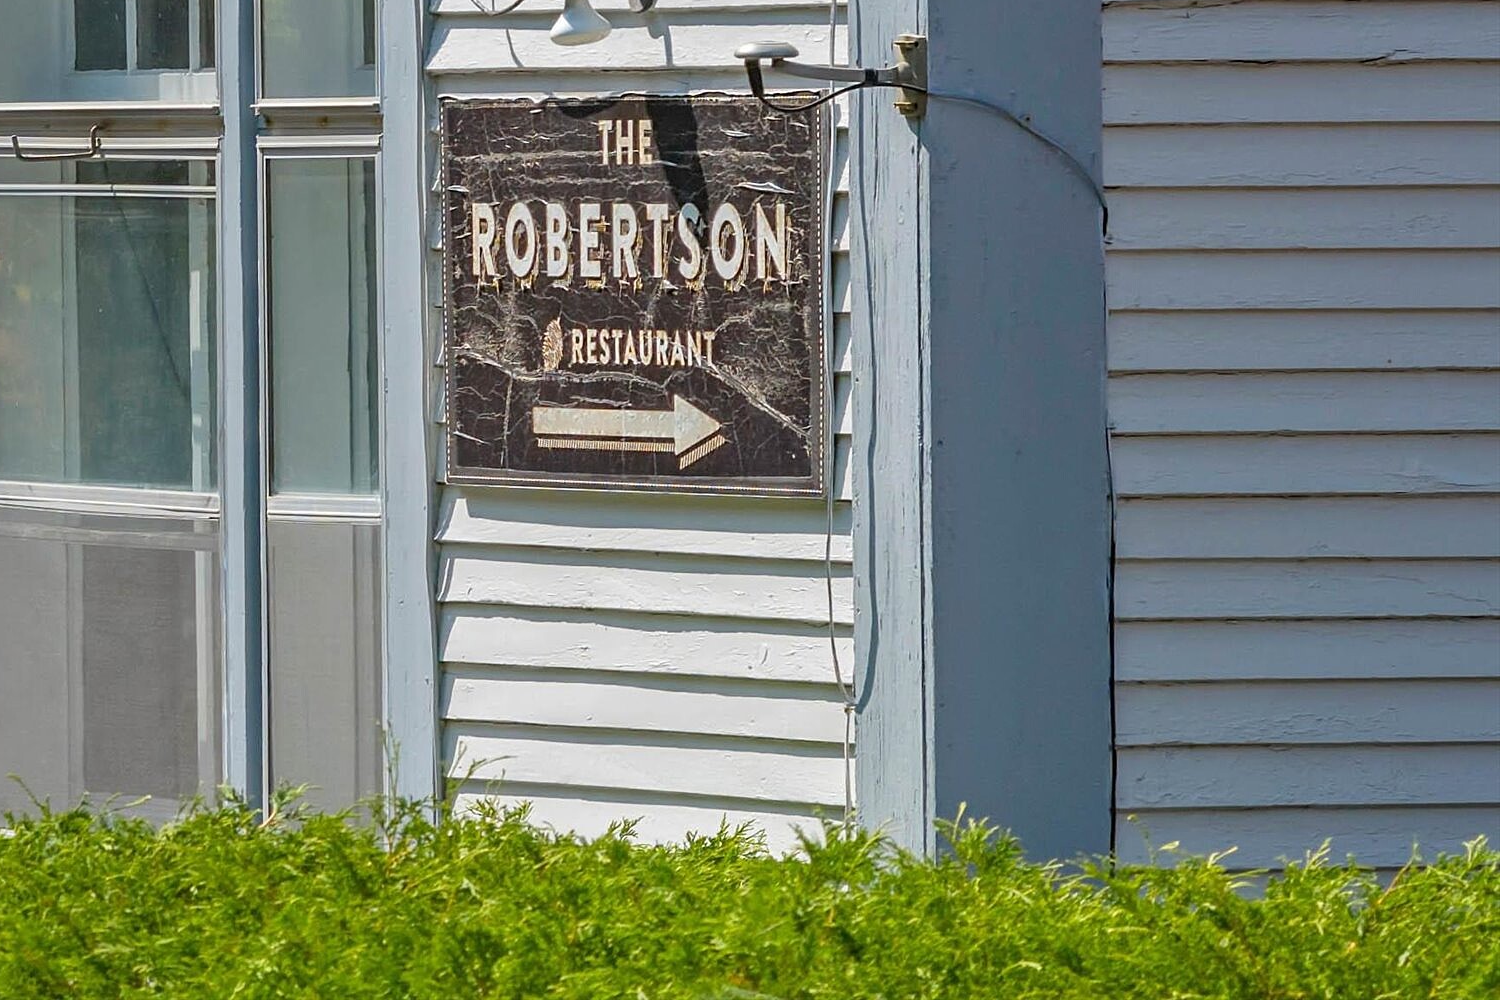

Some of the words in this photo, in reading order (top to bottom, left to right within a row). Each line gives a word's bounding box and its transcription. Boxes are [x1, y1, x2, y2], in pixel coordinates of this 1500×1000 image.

[599, 119, 654, 165] THE
[472, 202, 789, 280] ROBERTSON
[571, 328, 716, 367] RESTAURANT
